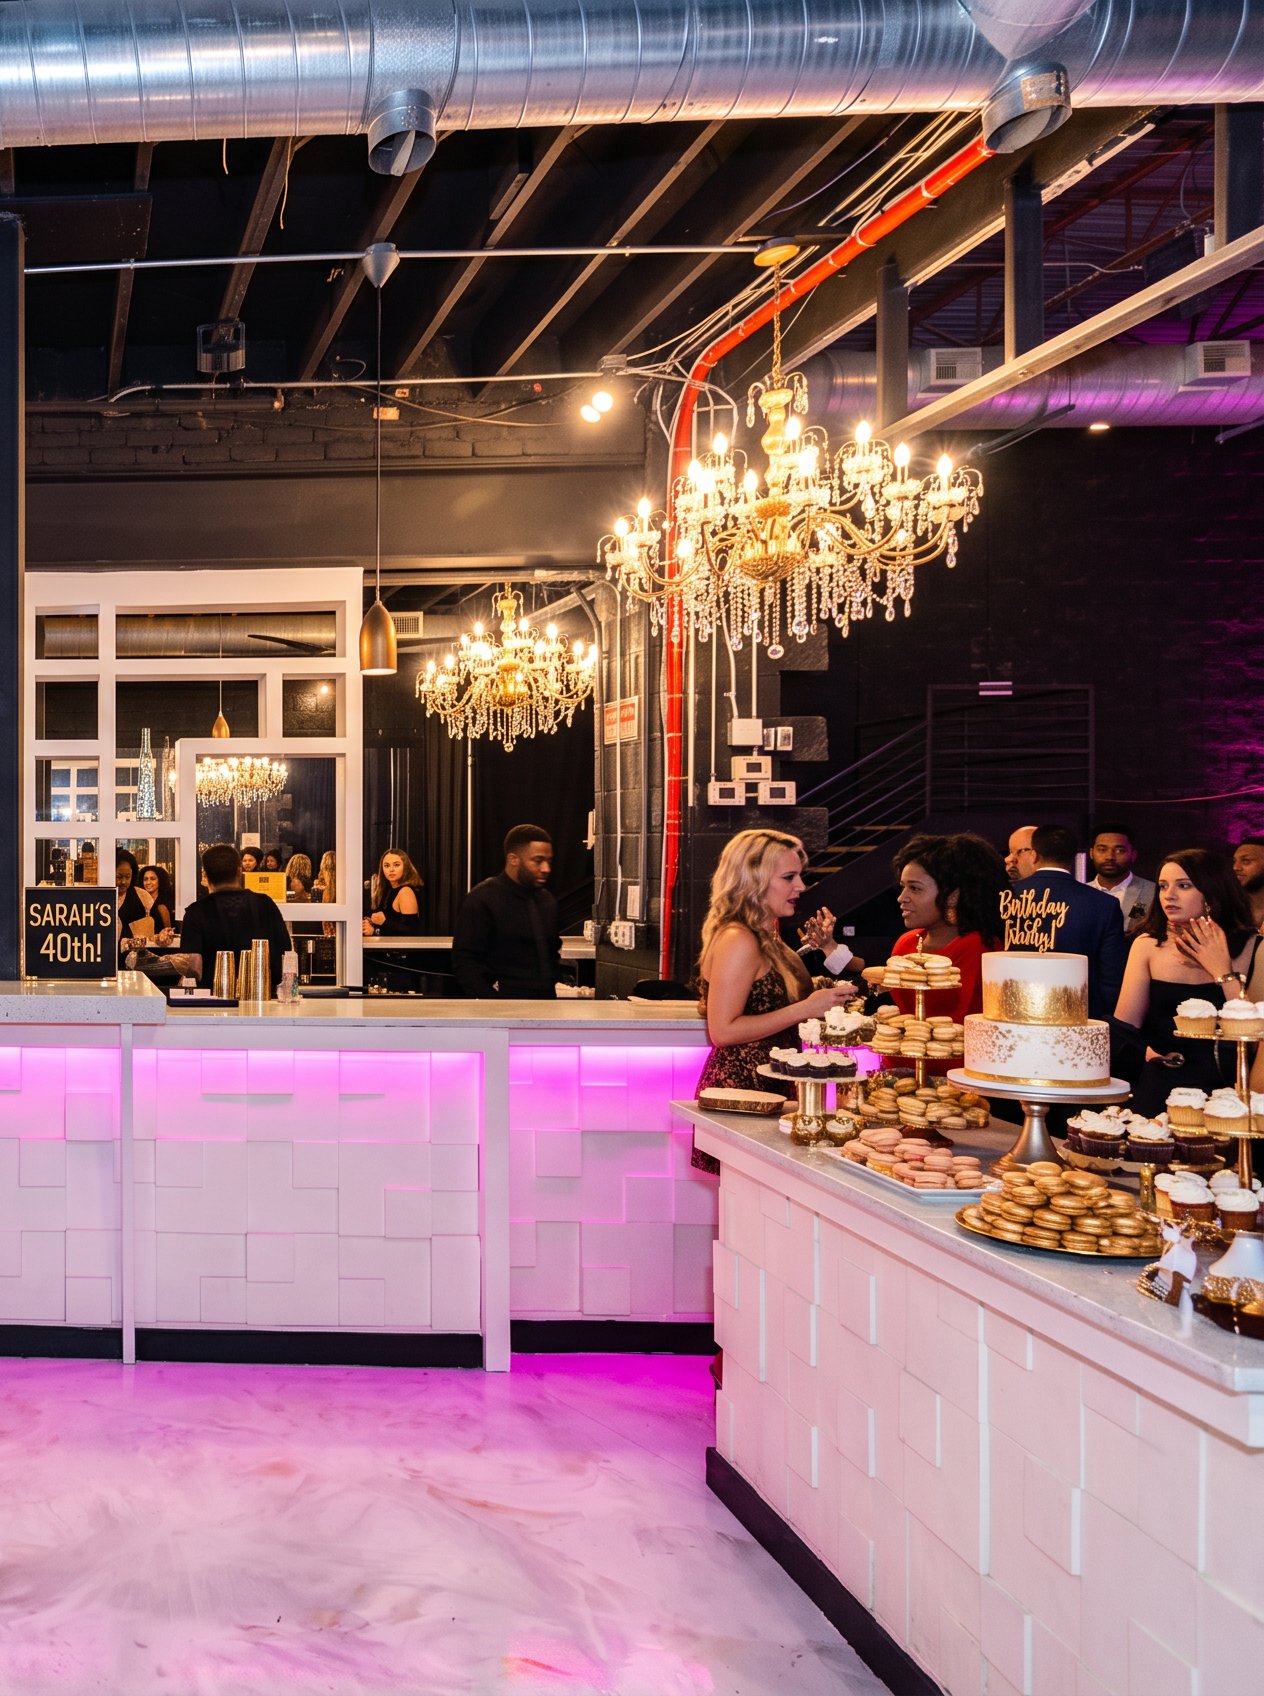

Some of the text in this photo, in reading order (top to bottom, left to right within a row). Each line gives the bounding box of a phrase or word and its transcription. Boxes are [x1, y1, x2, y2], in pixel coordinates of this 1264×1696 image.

[29, 902, 112, 927] SARAH'S
[999, 888, 1069, 928] Birthday
[39, 932, 102, 963] 40th!
